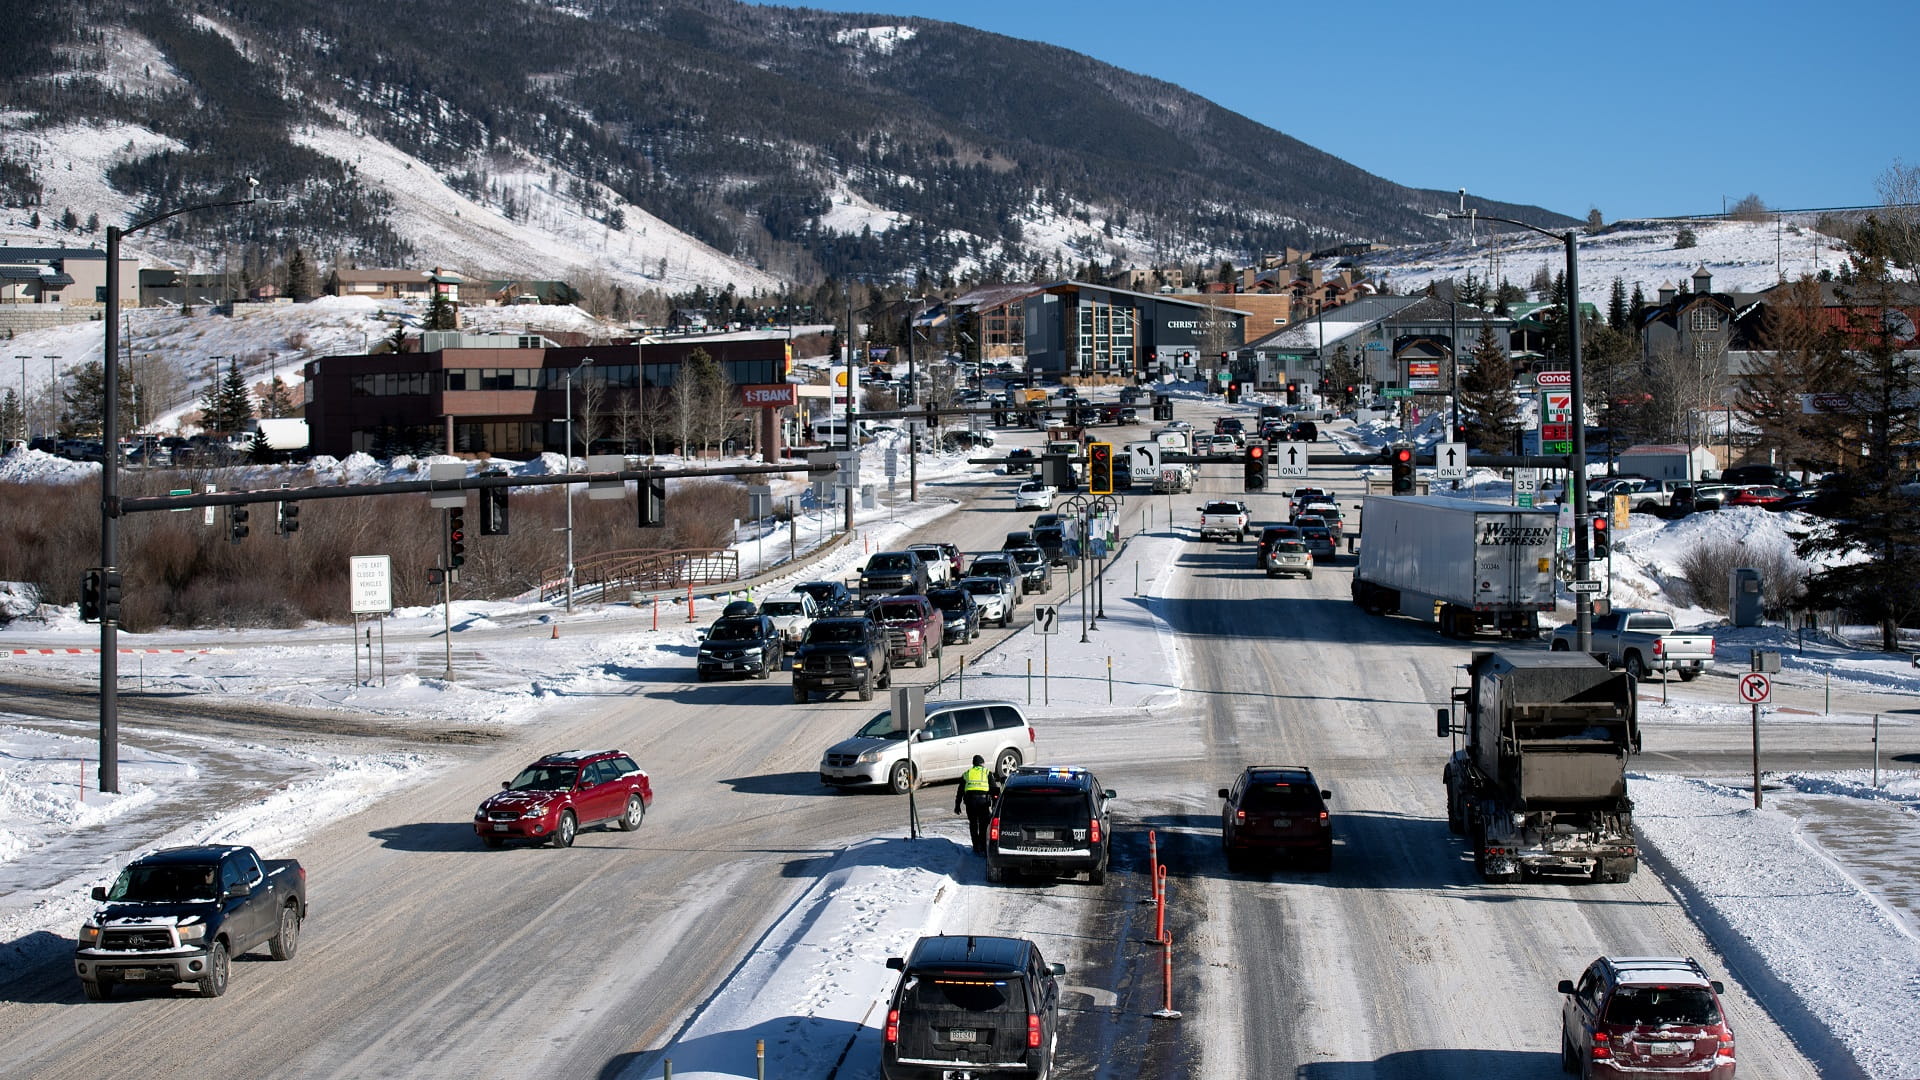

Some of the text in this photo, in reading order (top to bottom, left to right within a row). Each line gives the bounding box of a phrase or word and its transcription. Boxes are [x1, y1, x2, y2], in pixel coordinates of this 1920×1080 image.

[1167, 320, 1204, 329] CHRISTY
[1540, 375, 1571, 383] conoc
[745, 388, 791, 402] 1STBANK
[1135, 467, 1156, 475] ONLY
[1282, 467, 1303, 475] ONLY
[1517, 480, 1534, 490] 35
[1486, 522, 1552, 537] WESTERN
[1016, 845, 1074, 853] SILVERTHORNE
